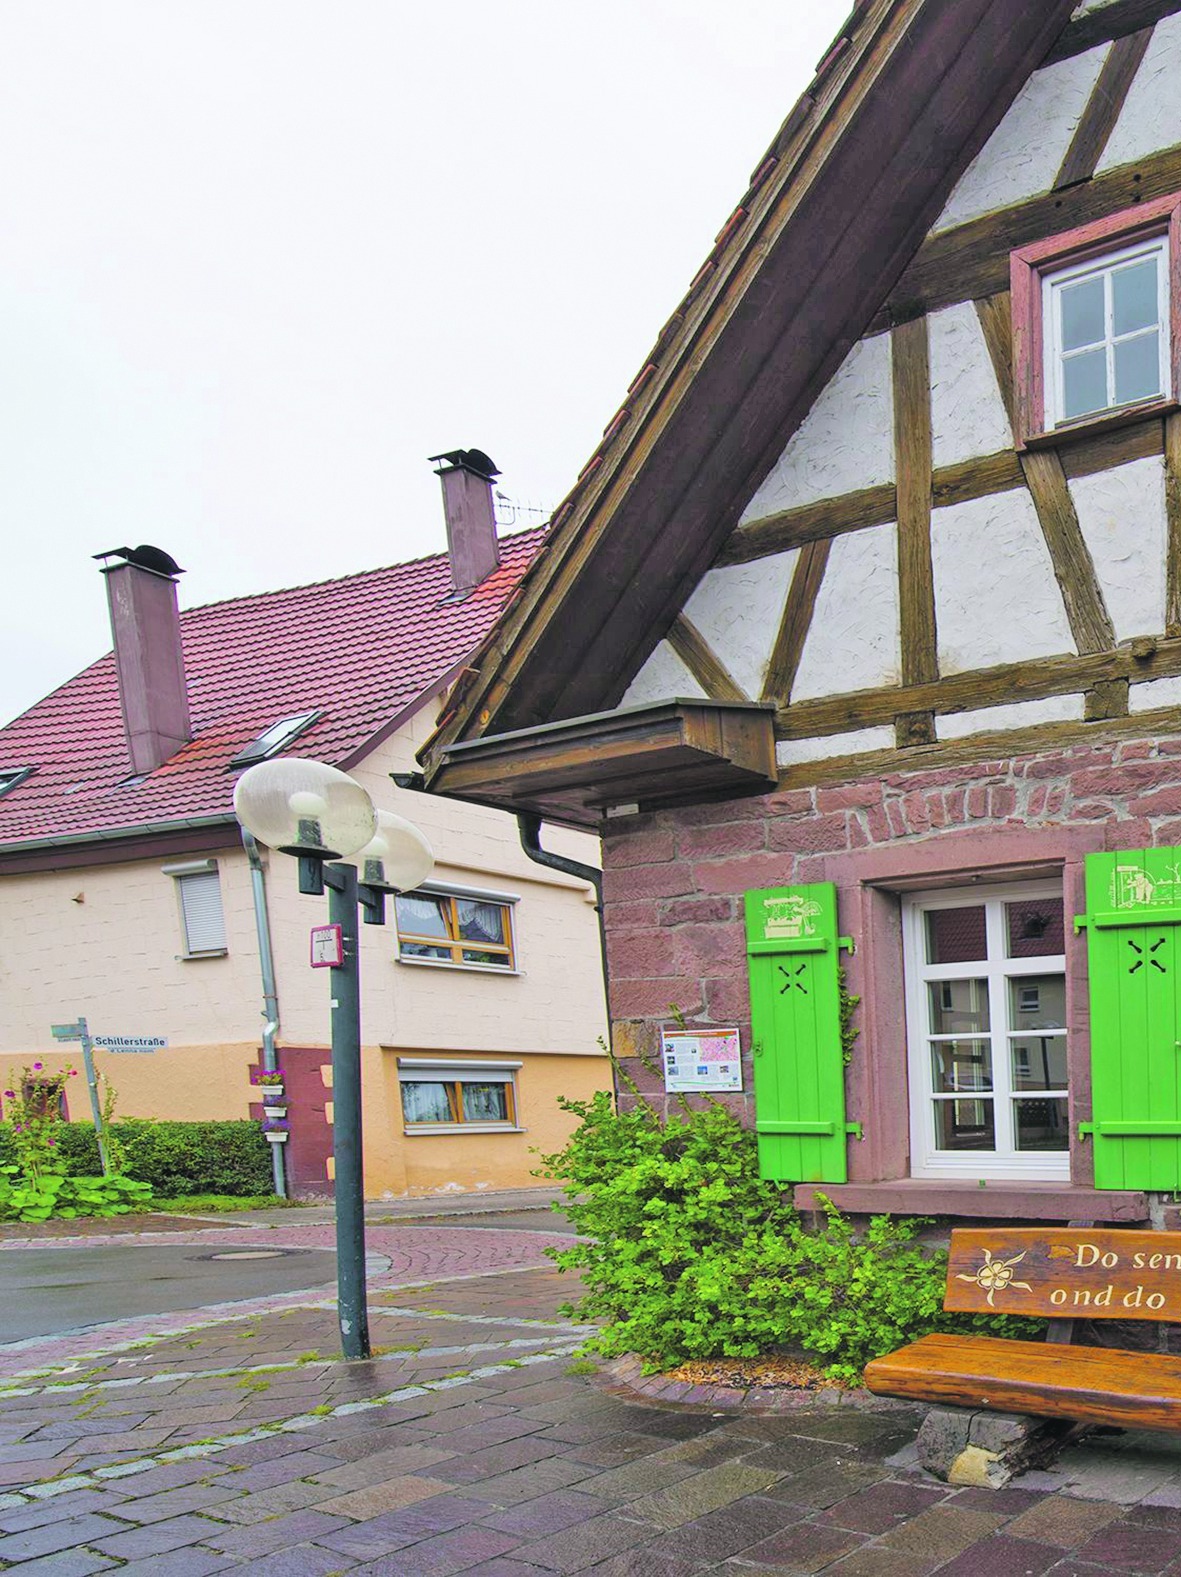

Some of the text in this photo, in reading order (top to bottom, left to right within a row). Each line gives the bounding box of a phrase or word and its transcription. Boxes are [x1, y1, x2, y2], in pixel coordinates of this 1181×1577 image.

[95, 1036, 165, 1047] Schillerstraße
[1074, 1243, 1119, 1268] Do
[1050, 1285, 1114, 1306] ond
[1123, 1286, 1166, 1309] do
